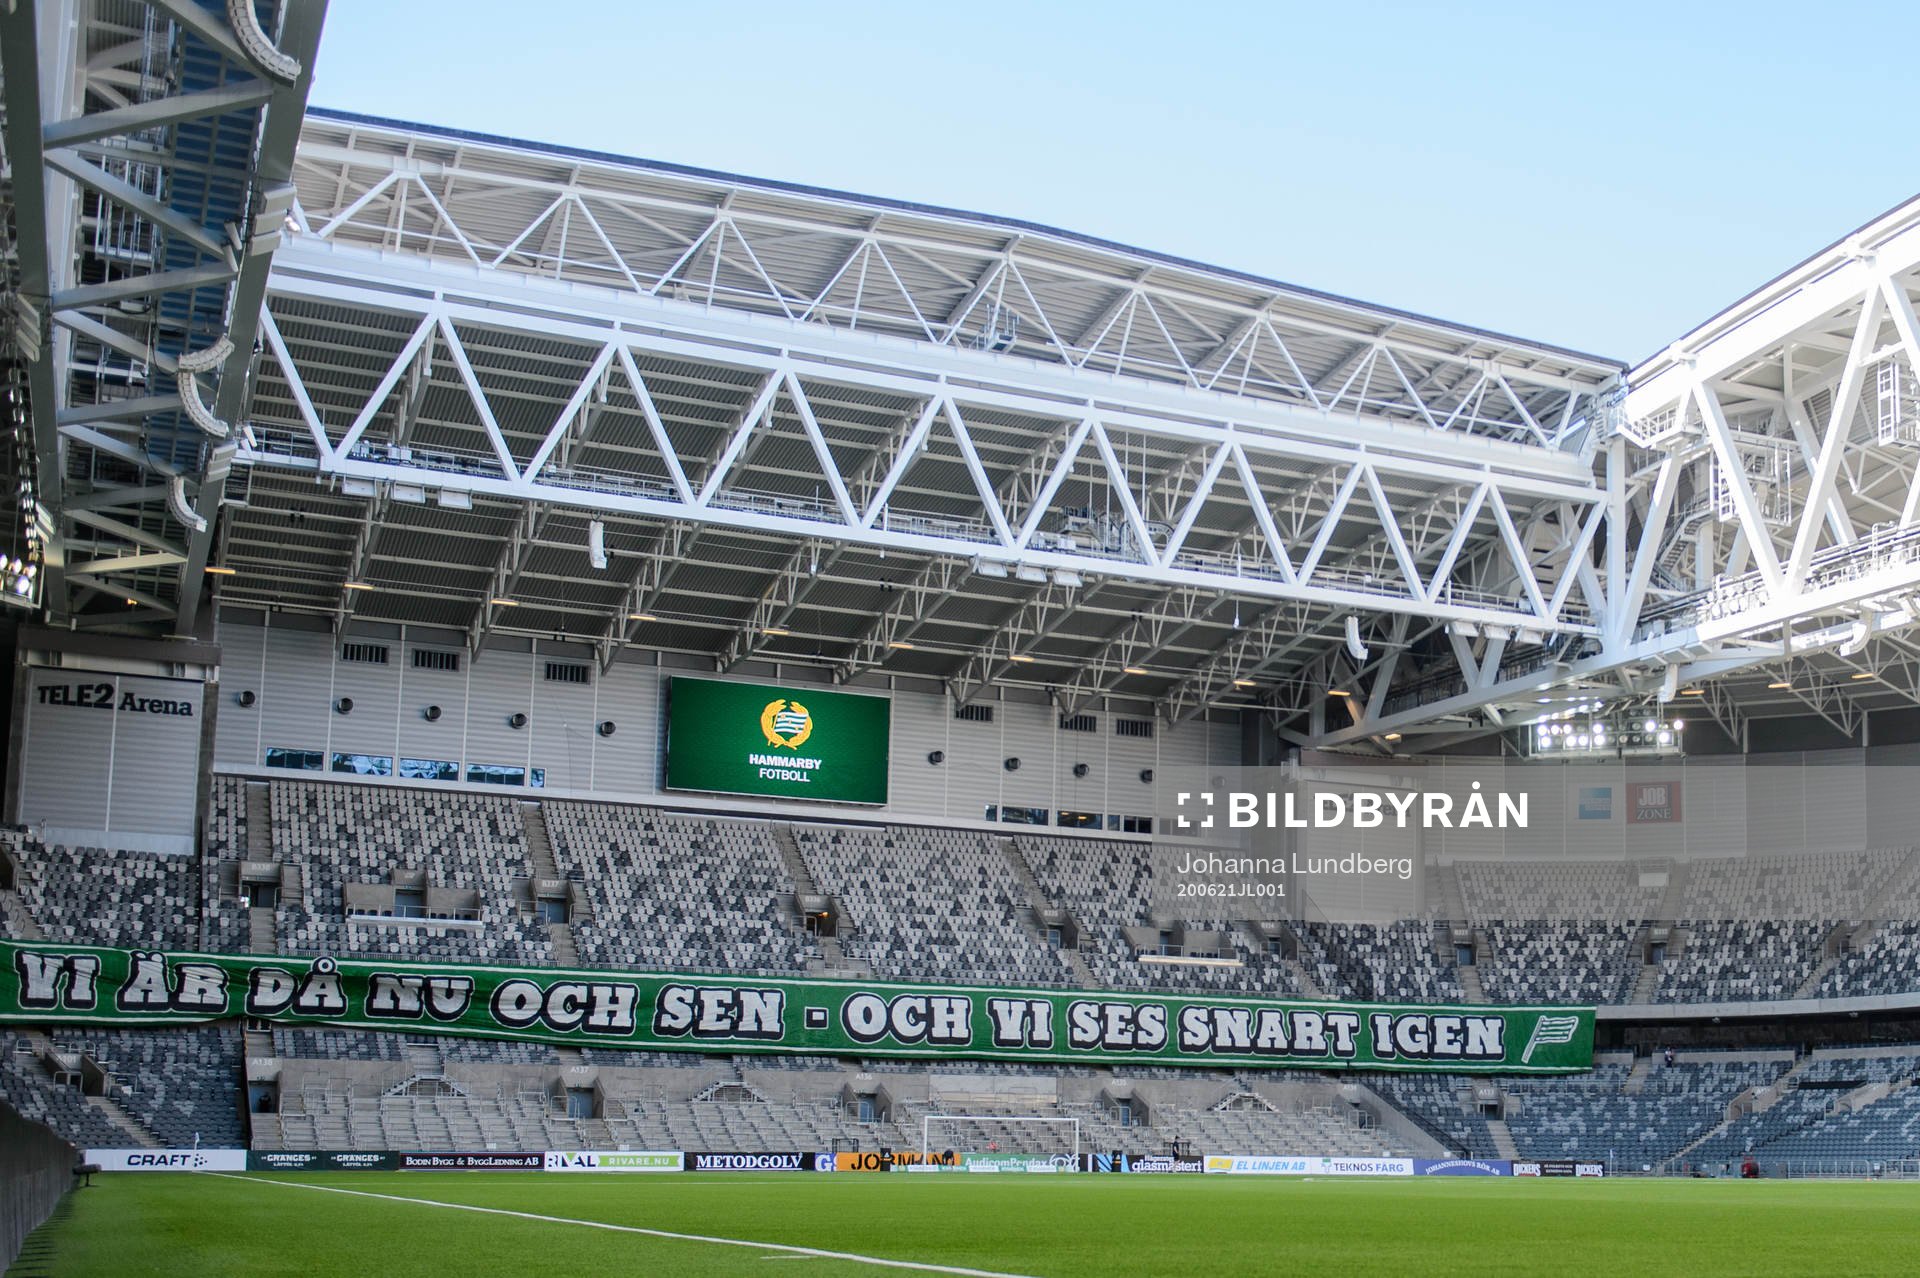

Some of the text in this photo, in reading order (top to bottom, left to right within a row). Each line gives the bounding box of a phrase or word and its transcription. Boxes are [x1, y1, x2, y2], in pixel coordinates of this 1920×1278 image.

[38, 683, 193, 716] TELE2 Arena
[749, 754, 822, 769] HAMMARBY
[759, 767, 811, 782] FOTBOLL
[1638, 787, 1667, 806] JOB
[1637, 807, 1672, 820] ZONE
[16, 950, 100, 1011] VI
[117, 951, 229, 1013] ÄR
[246, 957, 346, 1016] DÅ
[364, 972, 474, 1021] NU
[489, 978, 642, 1035] OCH
[652, 982, 785, 1042] SEN
[840, 991, 972, 1046] OCH
[987, 998, 1053, 1049] VI
[1066, 1000, 1168, 1052] SES
[1178, 1005, 1360, 1059] SNART
[1369, 1013, 1505, 1061] IGEN
[127, 1154, 191, 1166] CRAFT
[524, 1157, 539, 1166] AB
[608, 1157, 670, 1166] RIVARE.NU
[696, 1154, 803, 1168] METODGOLV
[1236, 1161, 1306, 1171] EL LINJEN AB
[1334, 1162, 1373, 1172] TEKNOS
